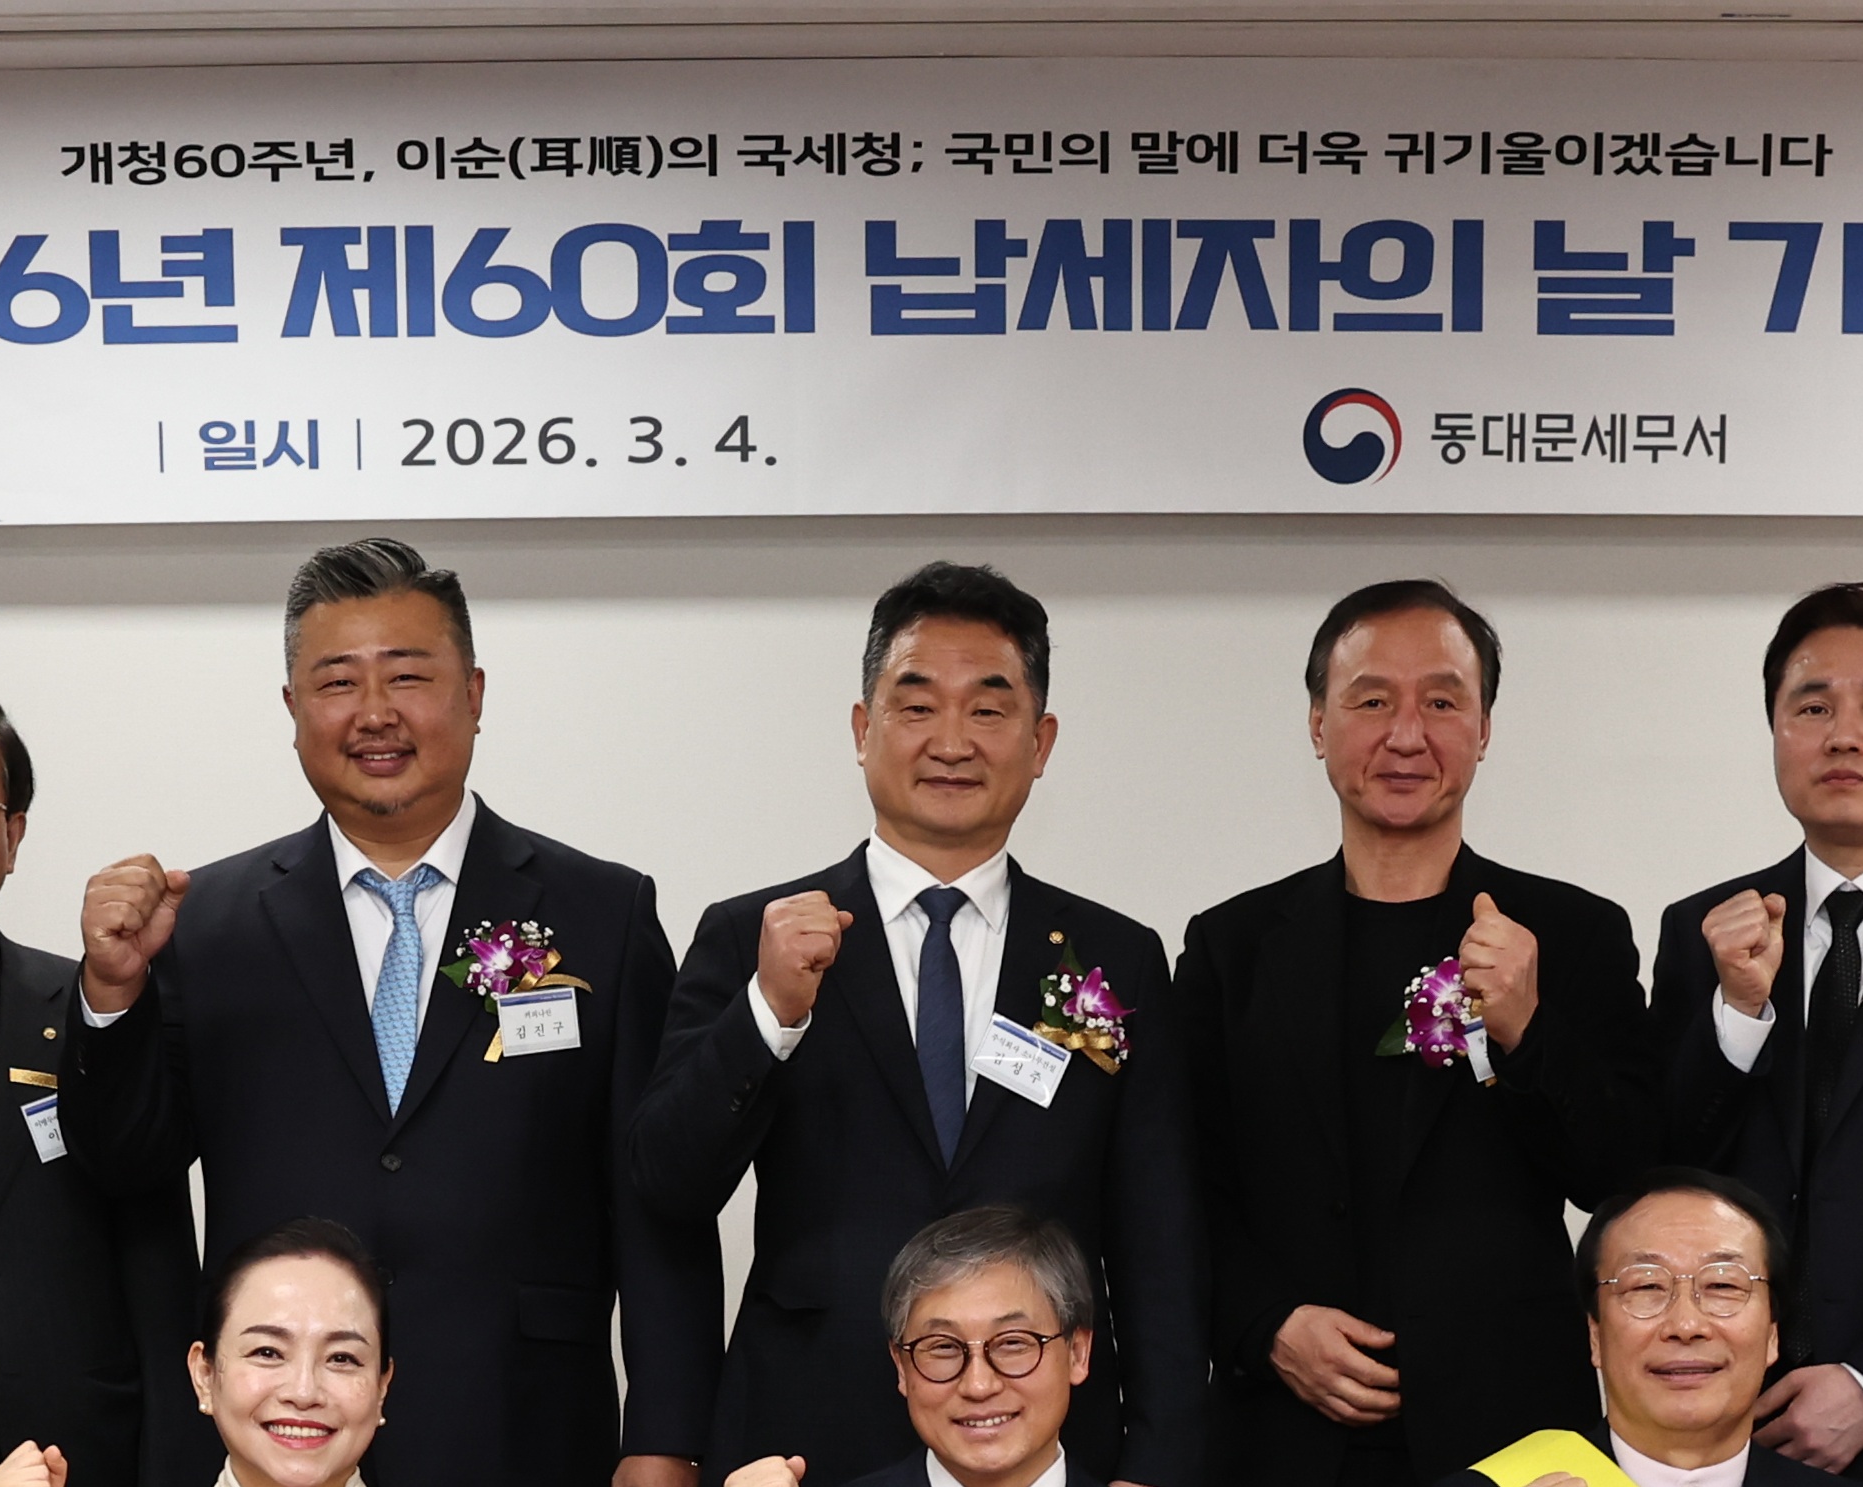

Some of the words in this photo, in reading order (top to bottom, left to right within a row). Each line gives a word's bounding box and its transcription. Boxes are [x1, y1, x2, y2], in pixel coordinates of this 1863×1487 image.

[60, 137, 374, 185] 개청60주년,
[397, 132, 718, 181] 이순(耳順)의
[736, 131, 924, 177] 국세청;
[944, 130, 1111, 175] 국민의
[1129, 130, 1239, 175] 말에
[1258, 130, 1369, 175] 더욱
[1383, 130, 1834, 177] 귀기울이겠습니다
[281, 220, 815, 338] 제60회
[865, 218, 1484, 335] 납세자의
[1533, 220, 1696, 336] 날
[199, 420, 319, 470] 일시
[402, 418, 597, 467] 2026.
[627, 417, 687, 466] 3.
[714, 416, 777, 465] 4.
[1430, 413, 1727, 464] 동대문세무서
